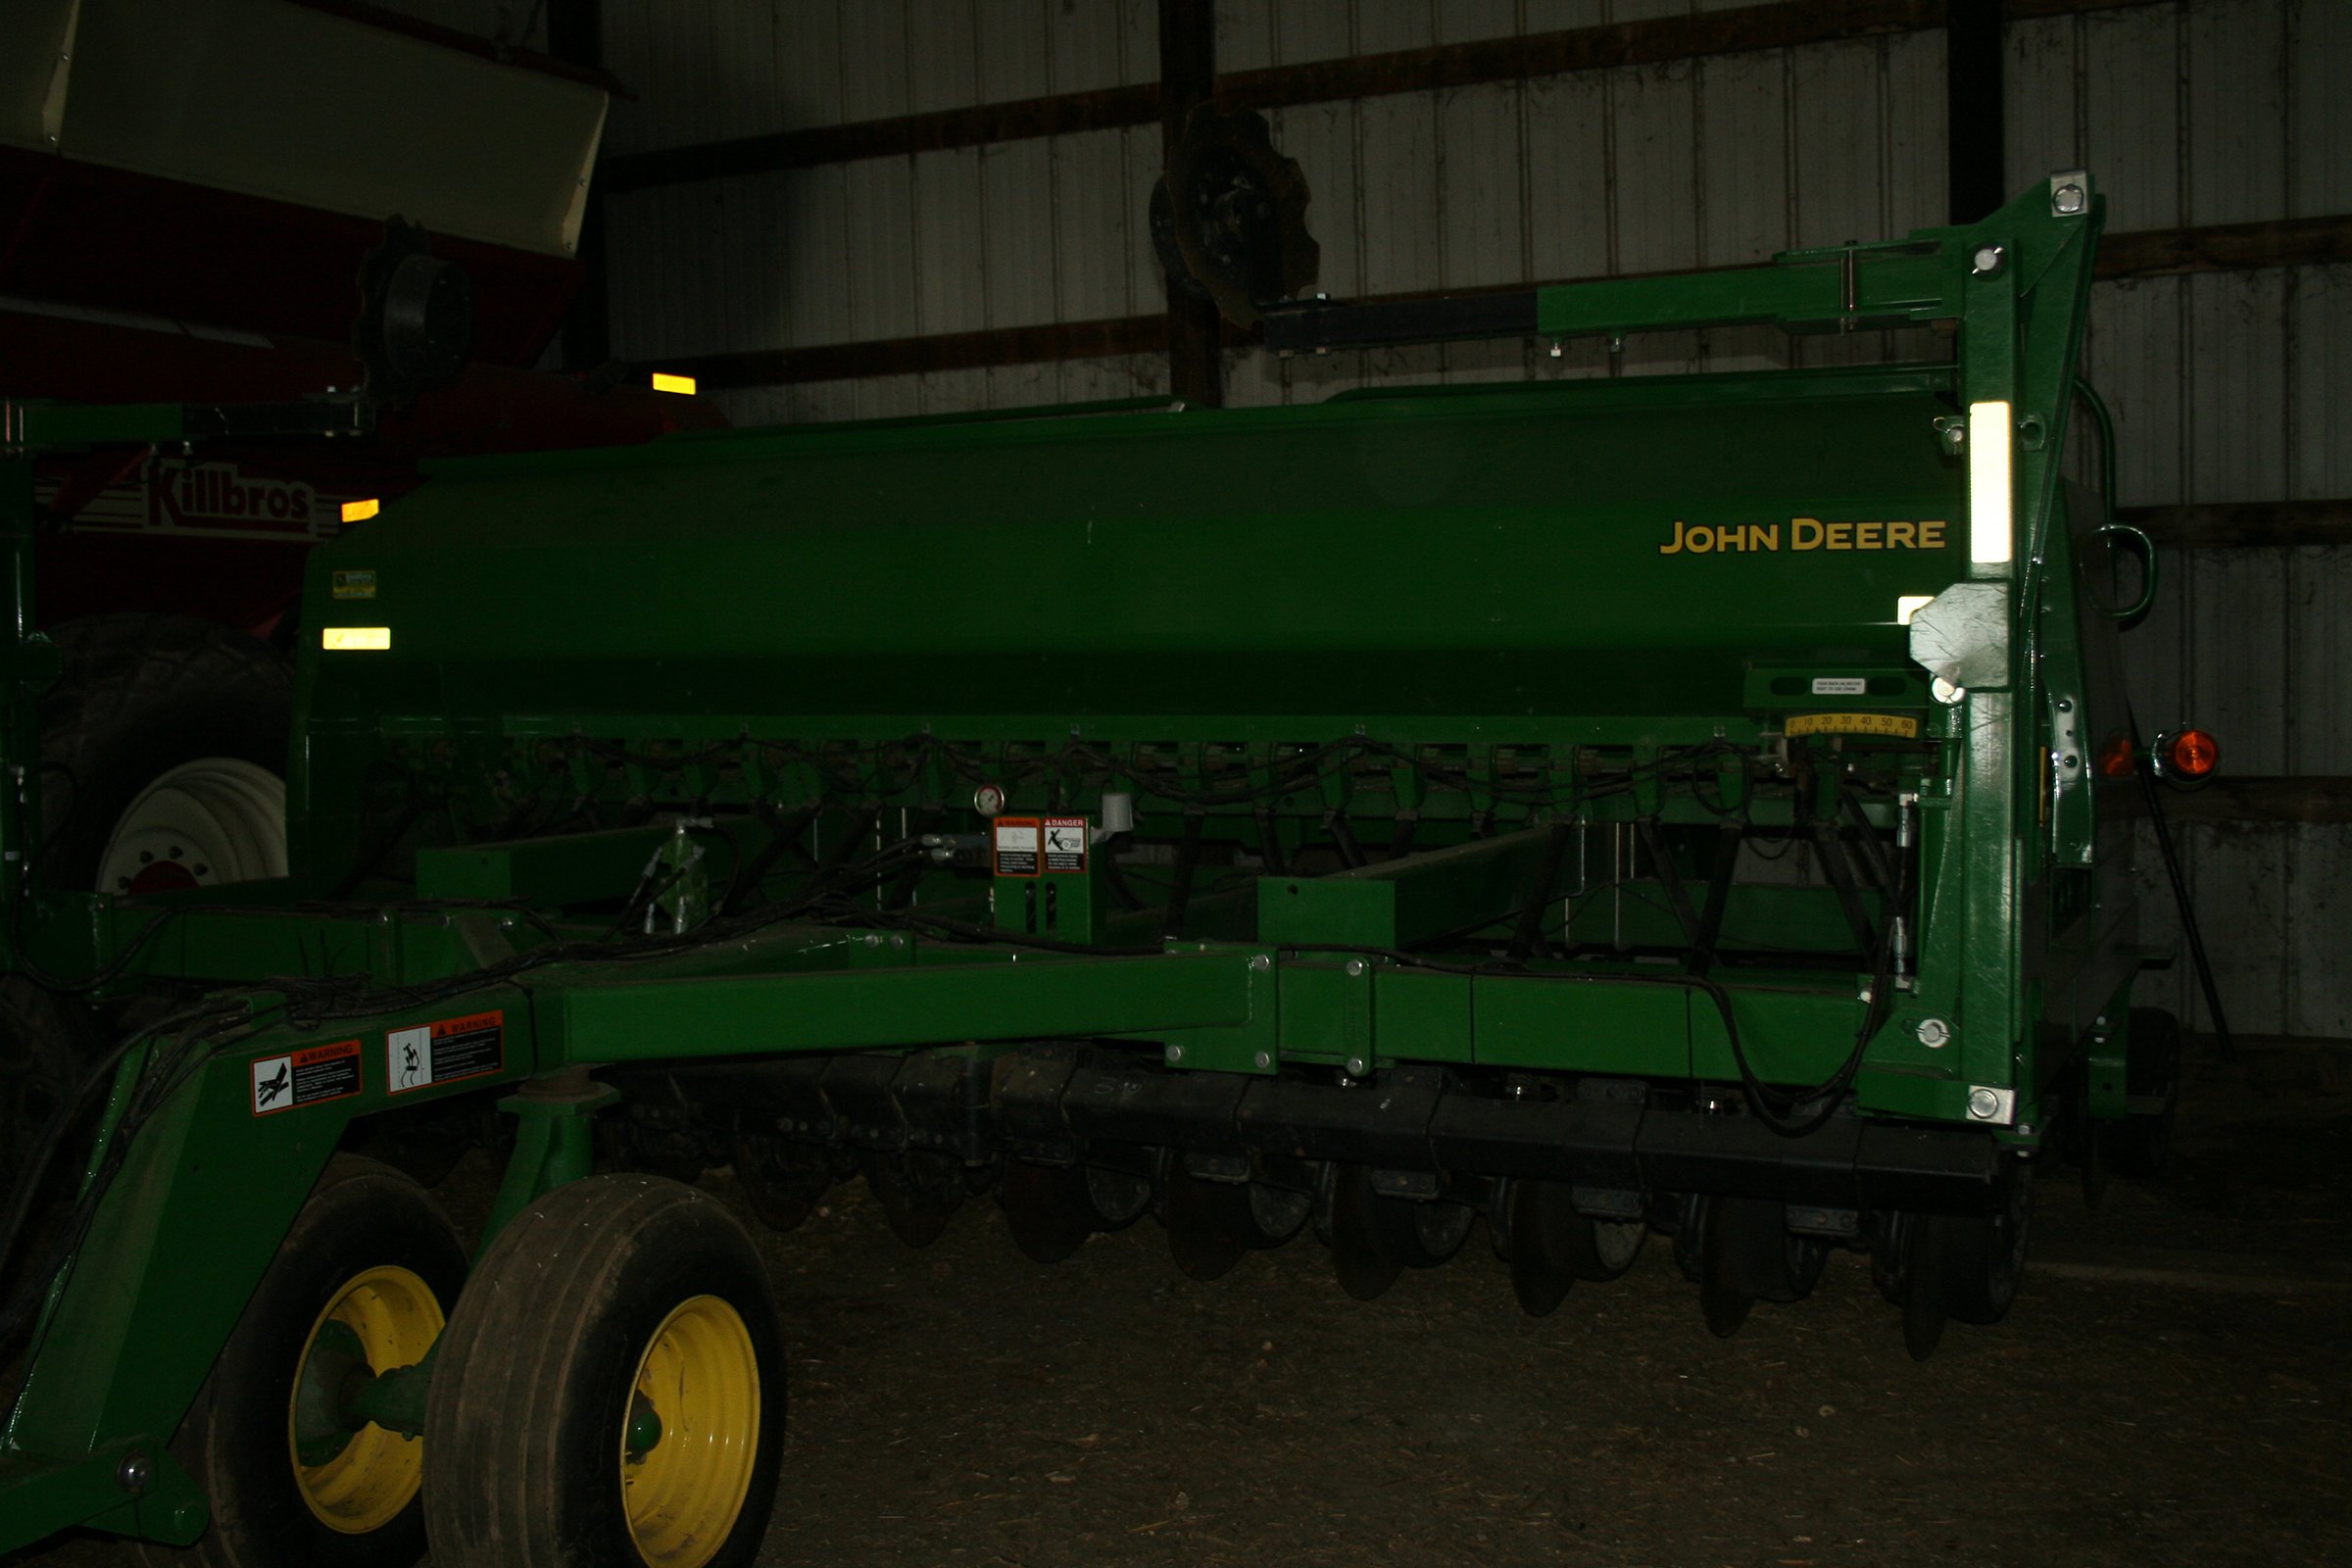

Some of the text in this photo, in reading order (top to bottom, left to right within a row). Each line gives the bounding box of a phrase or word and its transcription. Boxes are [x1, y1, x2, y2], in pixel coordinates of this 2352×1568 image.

[149, 466, 308, 526] Killbros
[1659, 517, 1946, 555] JOHN DEERE
[1822, 716, 1832, 725] 20
[1840, 716, 1851, 725] 30
[1860, 716, 1872, 725] 40
[1882, 717, 1892, 727] 50
[1901, 720, 1912, 729] 60
[452, 1016, 495, 1032] WARNING
[309, 1044, 353, 1059] WARNING
